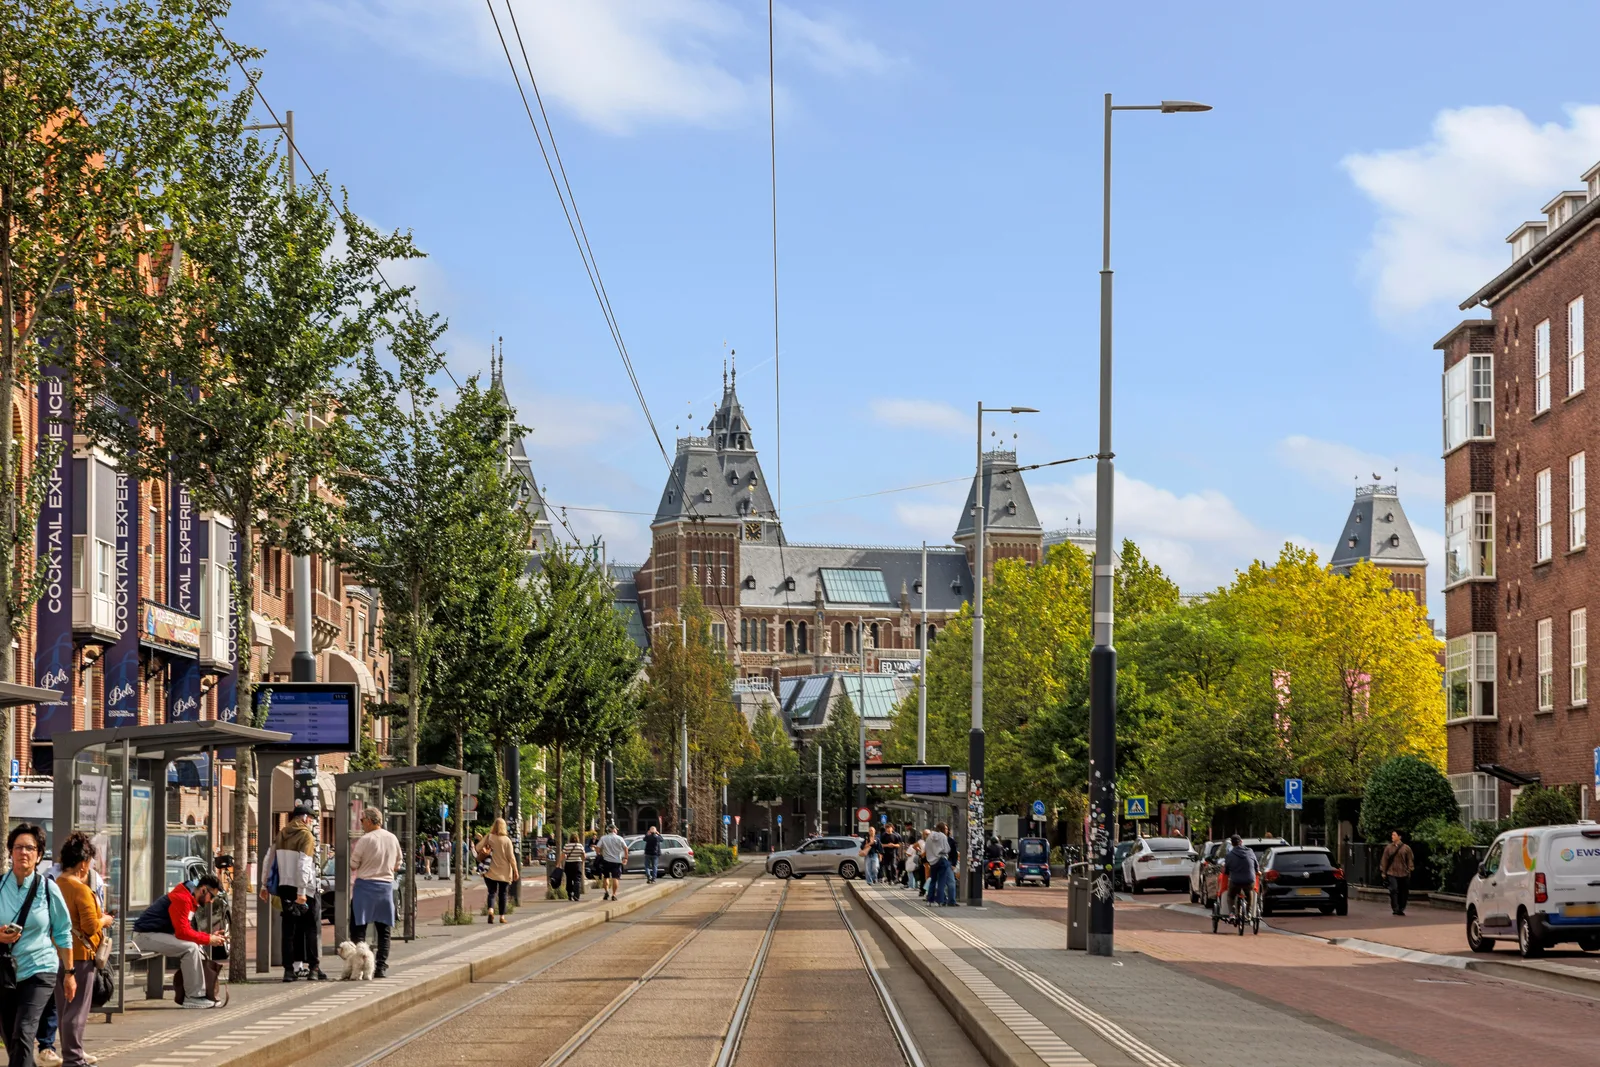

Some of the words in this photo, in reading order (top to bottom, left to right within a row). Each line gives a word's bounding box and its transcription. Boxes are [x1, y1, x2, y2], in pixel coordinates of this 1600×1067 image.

[116, 471, 128, 537] EXPERI
[179, 483, 191, 564] EXPERIEN
[48, 512, 63, 614] COCKTAIL
[116, 541, 128, 633] COCKTAIL
[179, 567, 191, 613] KTAIL
[228, 592, 237, 663] COCKTAI
[881, 661, 892, 670] ED
[40, 668, 69, 689] Bols
[108, 682, 135, 706] Bols
[173, 696, 198, 716] Bols
[221, 705, 238, 721] Bol
[1289, 781, 1299, 794] P
[1577, 848, 1600, 856] EWS
